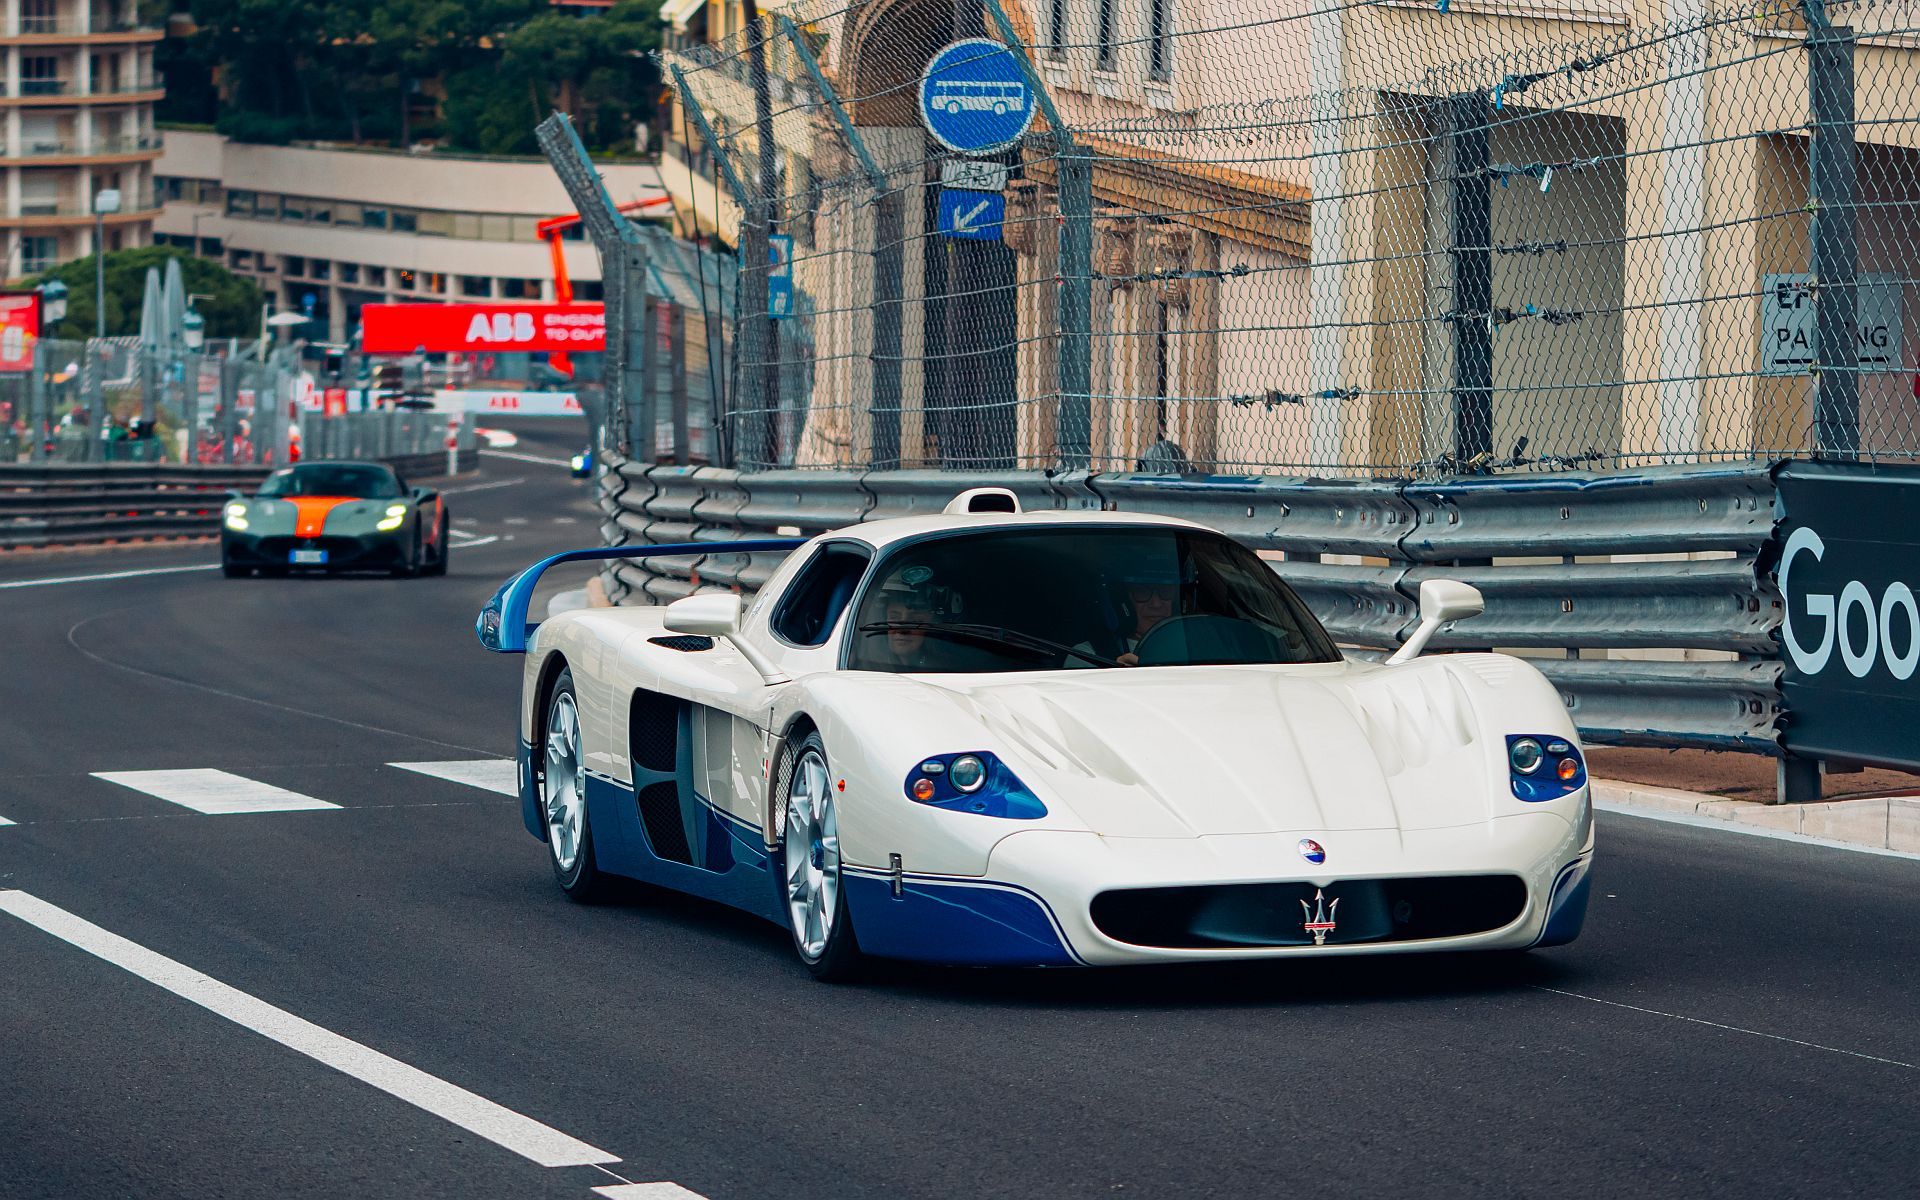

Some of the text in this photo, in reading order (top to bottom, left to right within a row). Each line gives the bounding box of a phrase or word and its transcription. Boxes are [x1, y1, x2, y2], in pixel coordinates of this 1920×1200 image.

[466, 313, 535, 342] ABB
[545, 328, 606, 341] TO OUT
[1777, 325, 1888, 349] PANG
[490, 396, 519, 409] ABB
[1778, 526, 1920, 681] Goo
